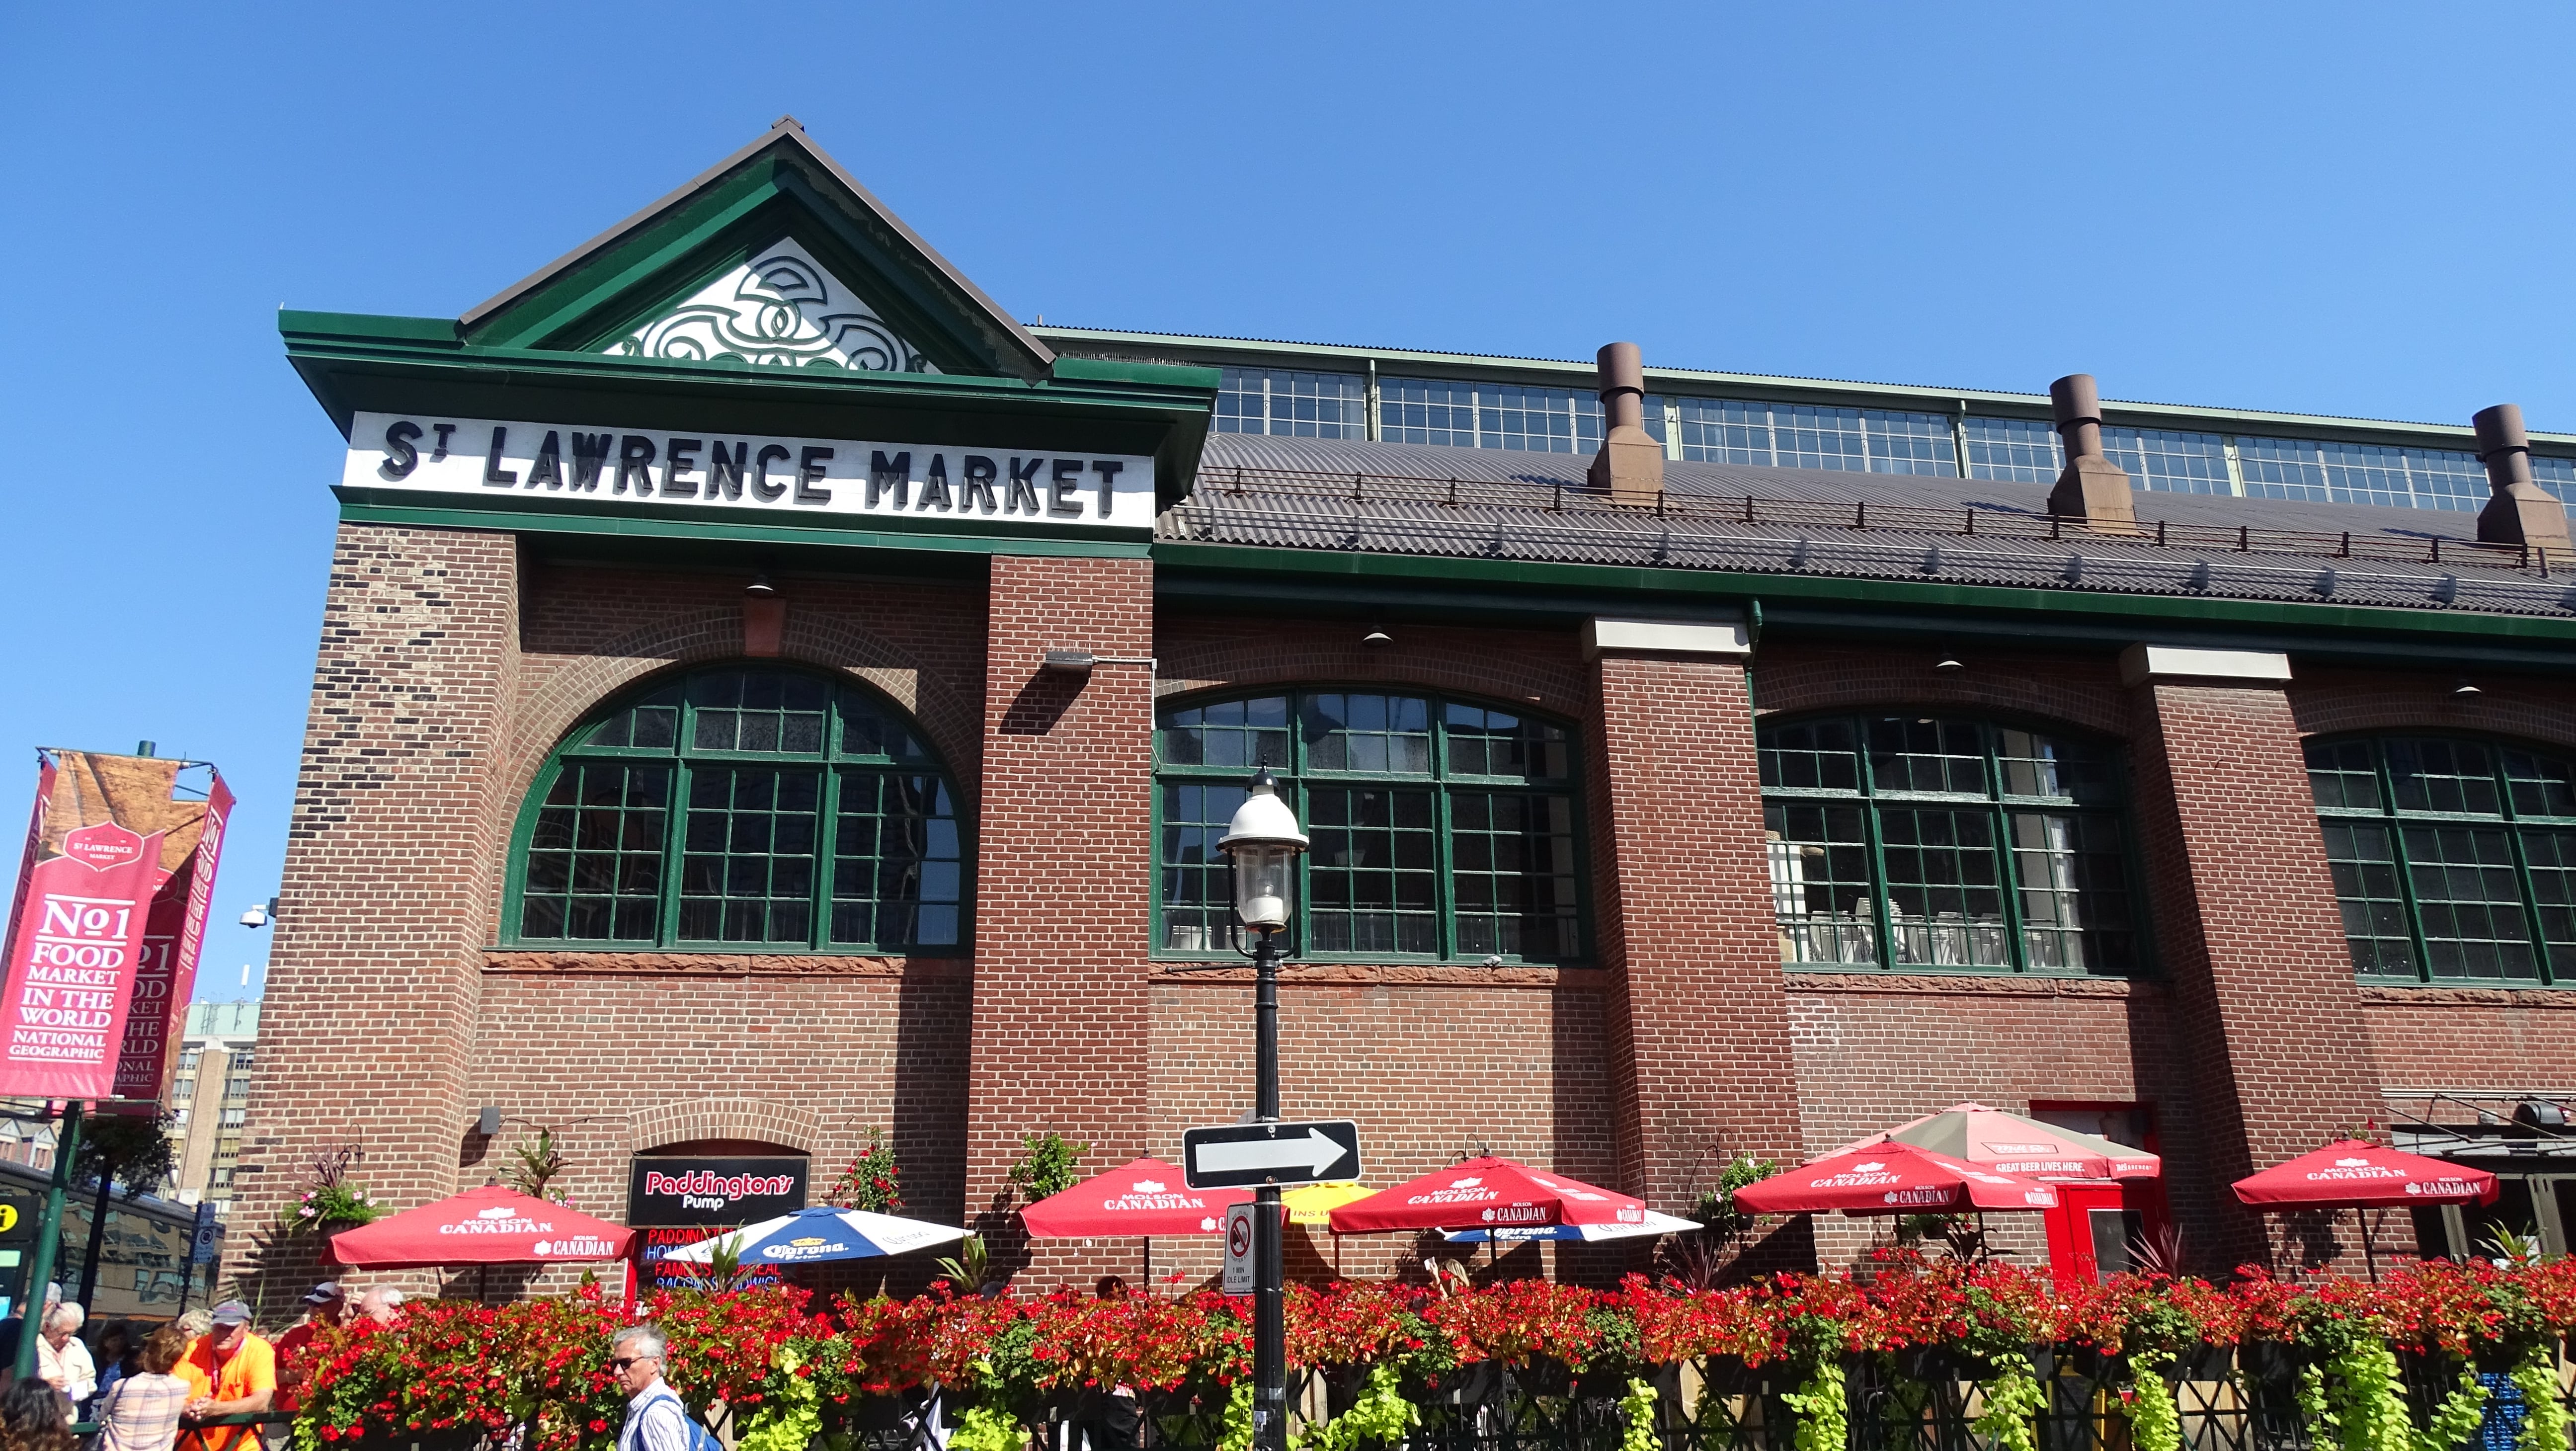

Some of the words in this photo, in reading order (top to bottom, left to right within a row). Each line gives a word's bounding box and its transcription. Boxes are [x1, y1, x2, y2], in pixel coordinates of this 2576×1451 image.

[484, 426, 834, 501] LAWRENCE
[869, 450, 1124, 516] MARKET
[84, 843, 133, 854] LAWRENCE
[31, 942, 124, 968] FOOD
[27, 965, 121, 985] MARKET
[21, 987, 55, 1007] IN
[60, 989, 115, 1010] THE
[19, 1006, 112, 1028] WORLD
[12, 1030, 106, 1047] NATIONAL
[9, 1045, 104, 1059] GEOGRAPHIC
[1996, 1162, 2020, 1172] GREAT
[2020, 1162, 2040, 1172] BEER
[2041, 1162, 2062, 1171] LIVES
[2063, 1162, 2085, 1172] HERE.
[1810, 1175, 1901, 1188] CANADIAN
[2306, 1169, 2407, 1180] CANADIAN
[645, 1170, 794, 1201] Paddington's
[1431, 1186, 1488, 1195] MOLSON
[2422, 1182, 2481, 1195] CANADIAN
[682, 1195, 724, 1211] Pump
[1104, 1198, 1204, 1210] CANADIAN
[1407, 1191, 1500, 1205] CANADIAN
[1900, 1190, 1949, 1204] CANADIAN
[1497, 1207, 1546, 1221] CANADIAN
[439, 1222, 553, 1234] CANADIAN
[553, 1240, 614, 1256] CANADIAN
